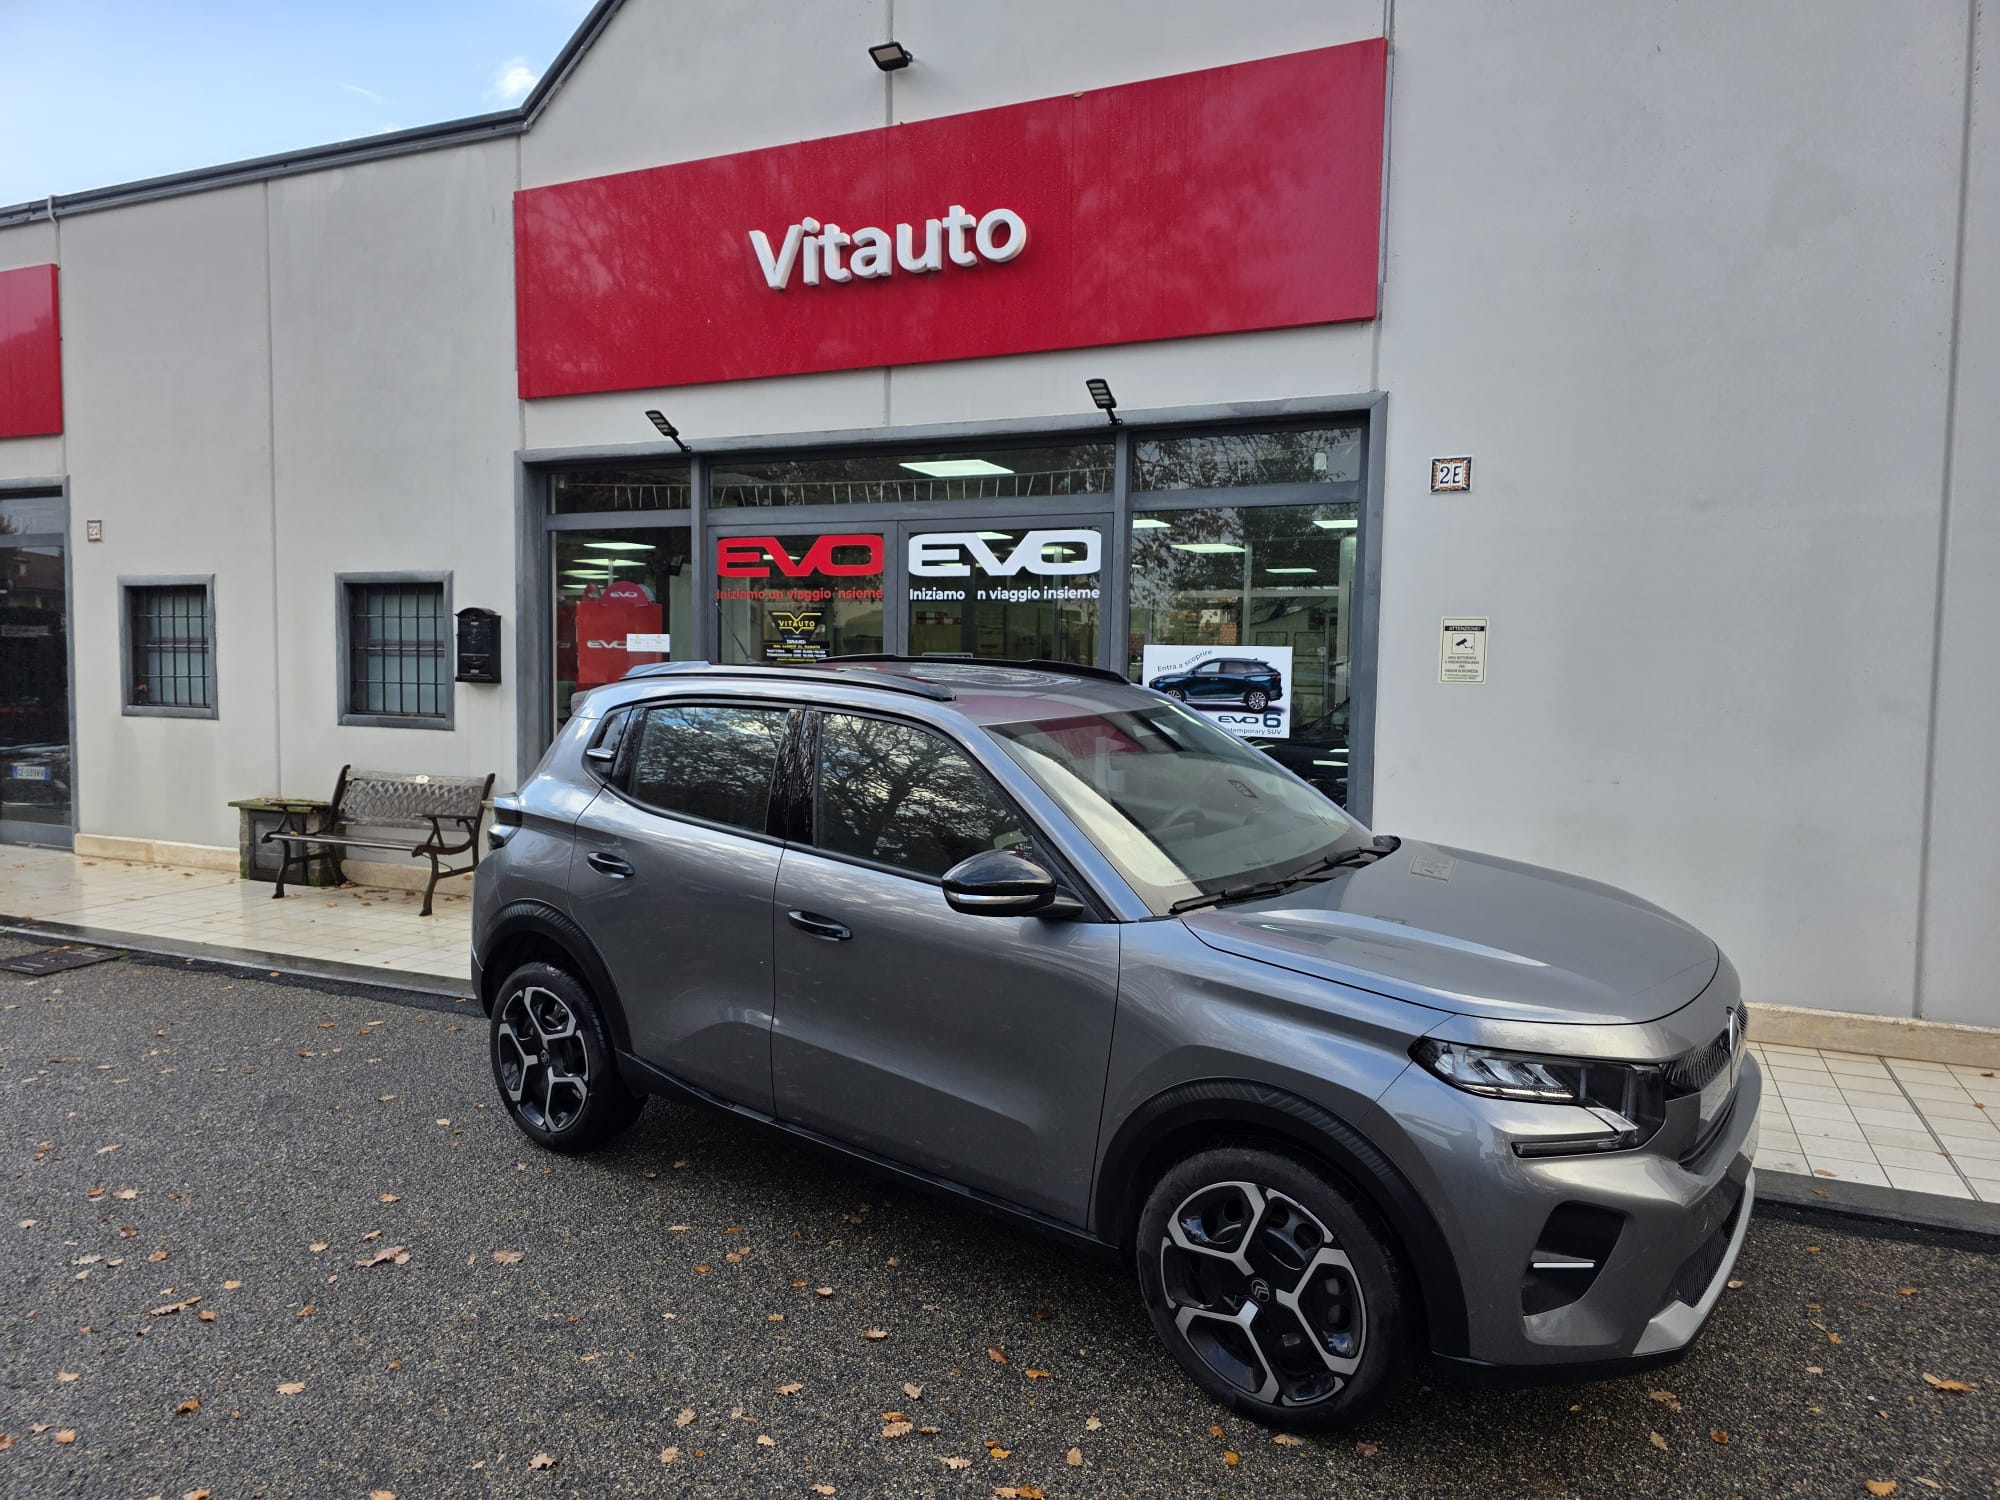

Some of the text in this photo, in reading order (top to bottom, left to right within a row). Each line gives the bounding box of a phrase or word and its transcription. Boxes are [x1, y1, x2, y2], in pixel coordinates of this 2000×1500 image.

[749, 204, 1027, 290] Vitauto
[1439, 465, 1462, 484] 2E
[717, 534, 884, 577] EVO
[908, 529, 1102, 577] EVO
[716, 586, 883, 602] Iniziamo un viaggio nsieme
[909, 586, 966, 601] Iniziamo
[990, 586, 1041, 602] viaggio
[1043, 585, 1100, 600] insieme
[1157, 663, 1177, 673] Entra
[1184, 649, 1213, 666] scoprire
[1218, 711, 1282, 728] EVO 6
[1227, 727, 1265, 736] temporary
